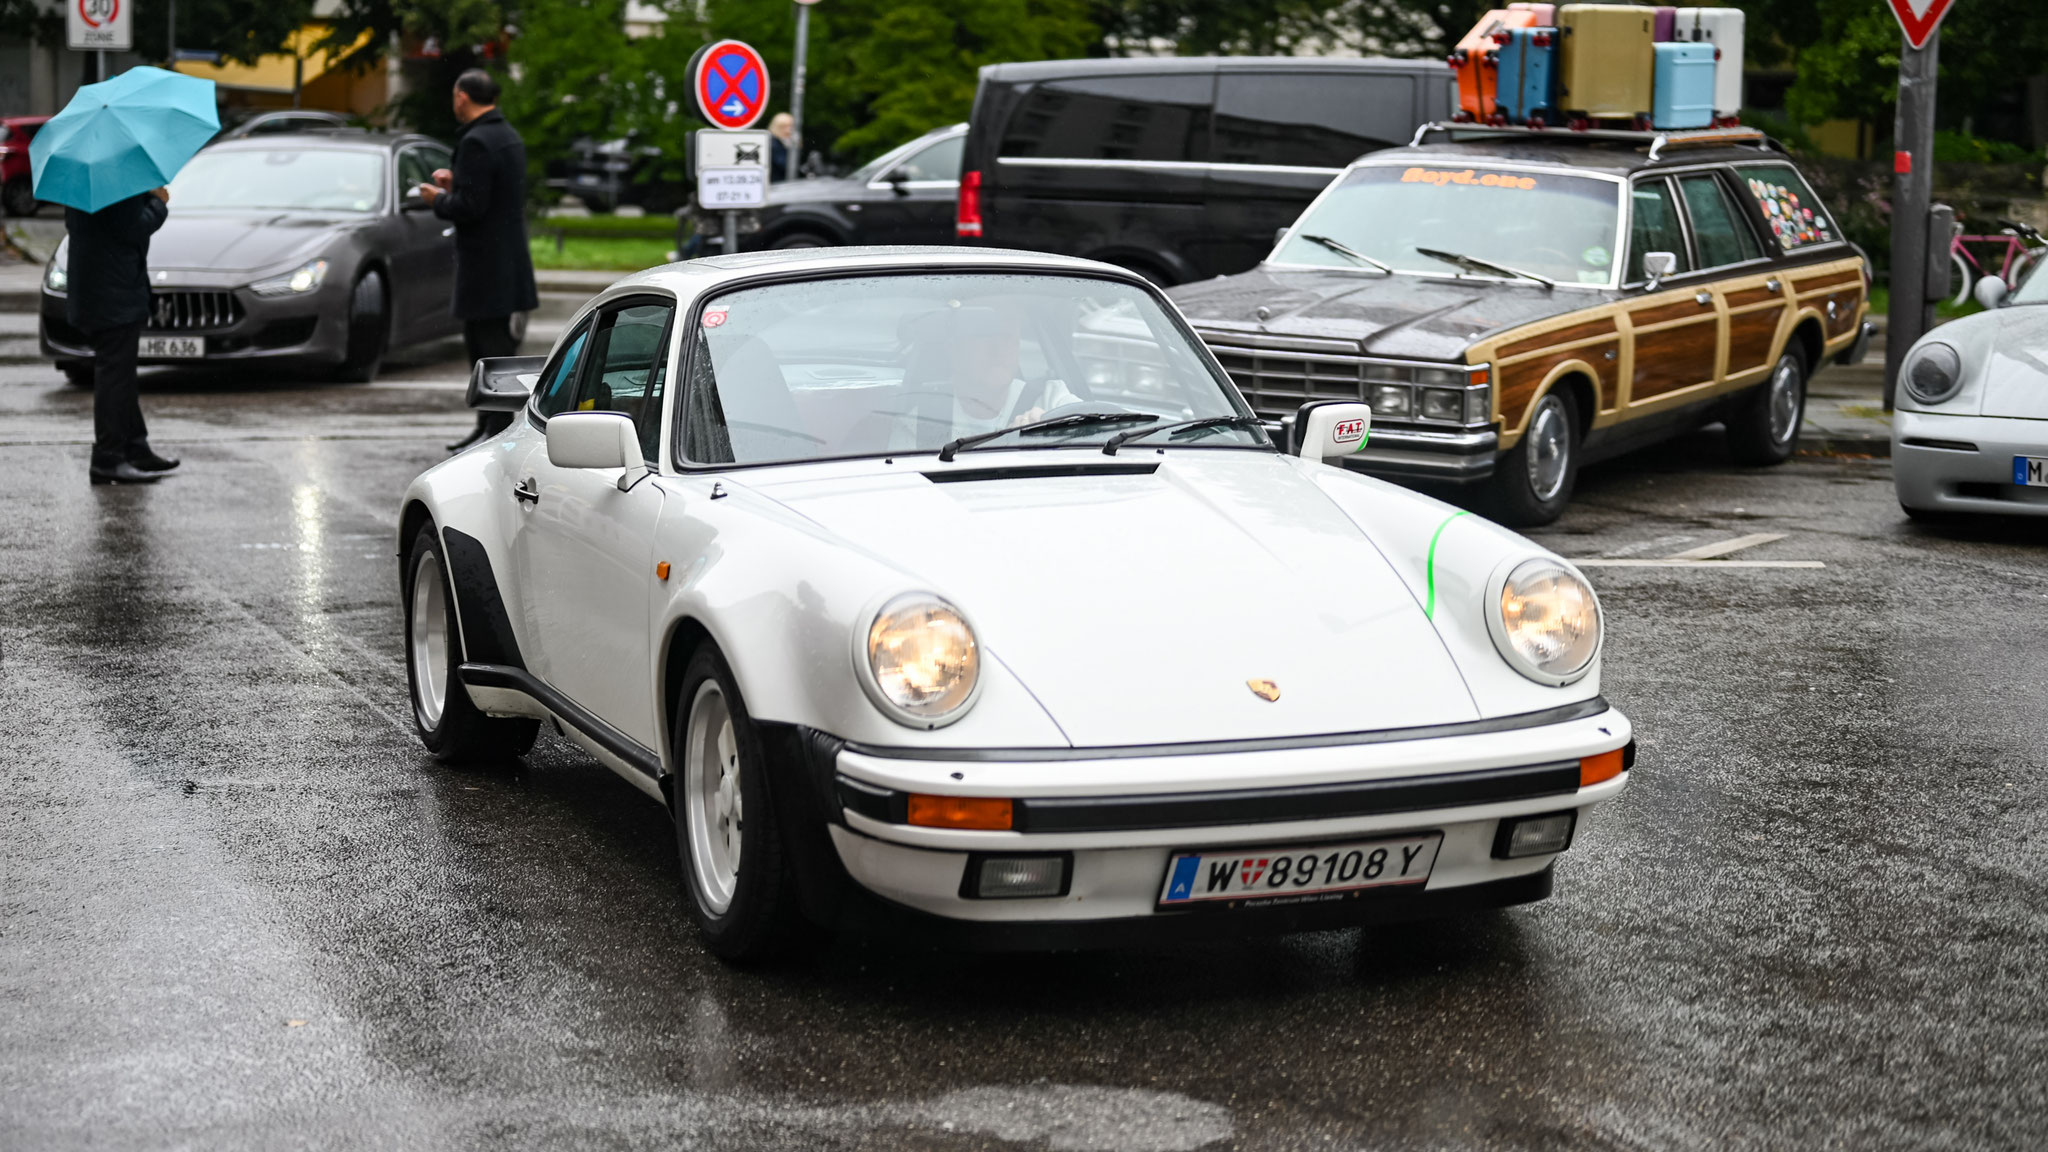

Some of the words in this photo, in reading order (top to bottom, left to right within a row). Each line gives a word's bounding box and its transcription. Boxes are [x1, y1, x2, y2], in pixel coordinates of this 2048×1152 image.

[86, 0, 110, 17] 30
[2027, 460, 2042, 483] M
[1206, 860, 1240, 893] W
[1267, 847, 1388, 888] 89108
[1399, 843, 1424, 877] Y
[1174, 882, 1185, 894] A
